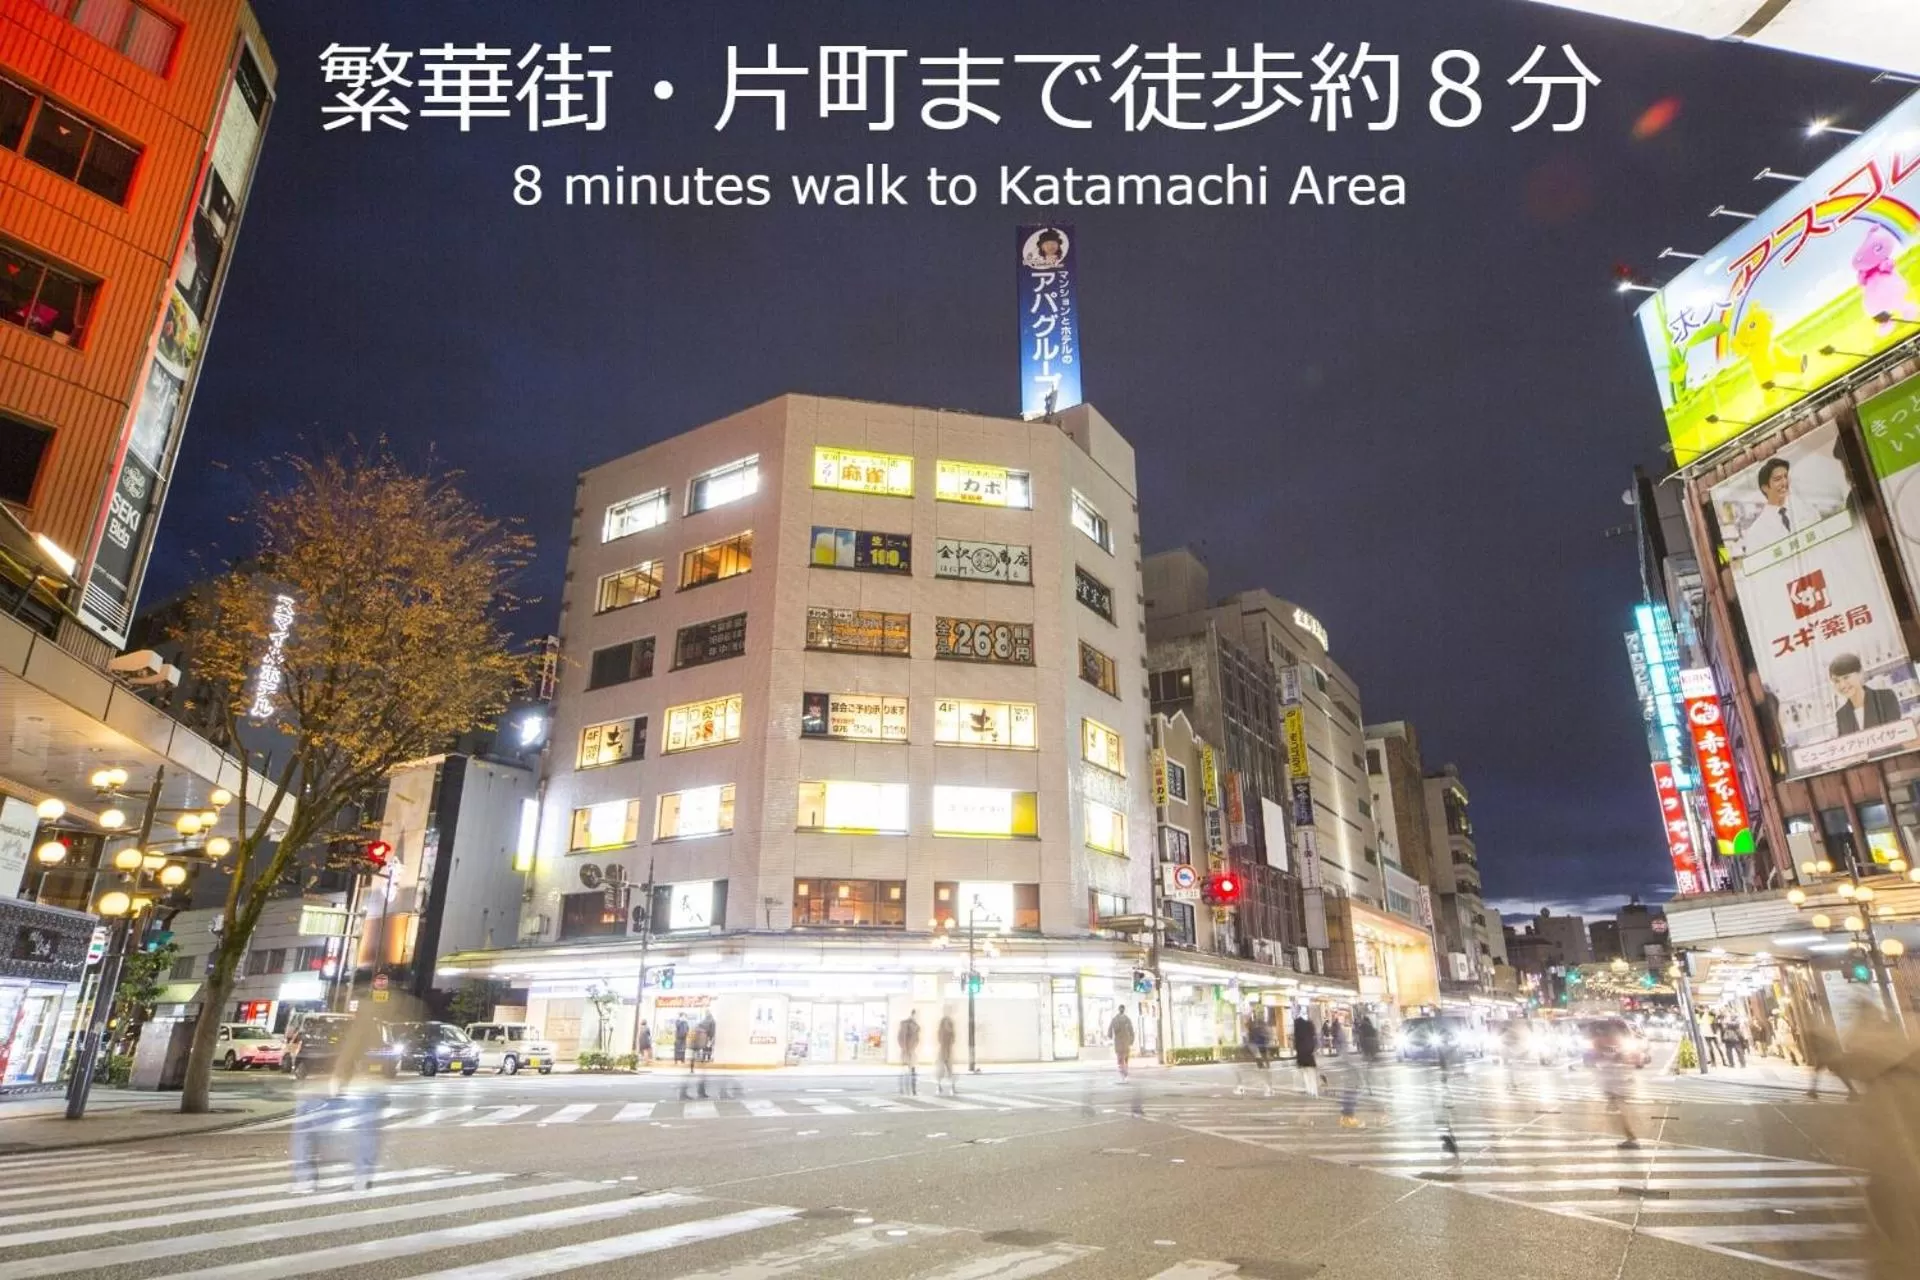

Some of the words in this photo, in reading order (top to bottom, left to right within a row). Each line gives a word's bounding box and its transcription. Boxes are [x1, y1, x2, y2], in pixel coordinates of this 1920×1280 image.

[1031, 272, 1062, 397] アパグループ
[1059, 271, 1073, 364] マンションとホテルの
[110, 491, 141, 532] SEKI
[955, 622, 1012, 658] 268
[1772, 604, 1873, 658] スギ薬局
